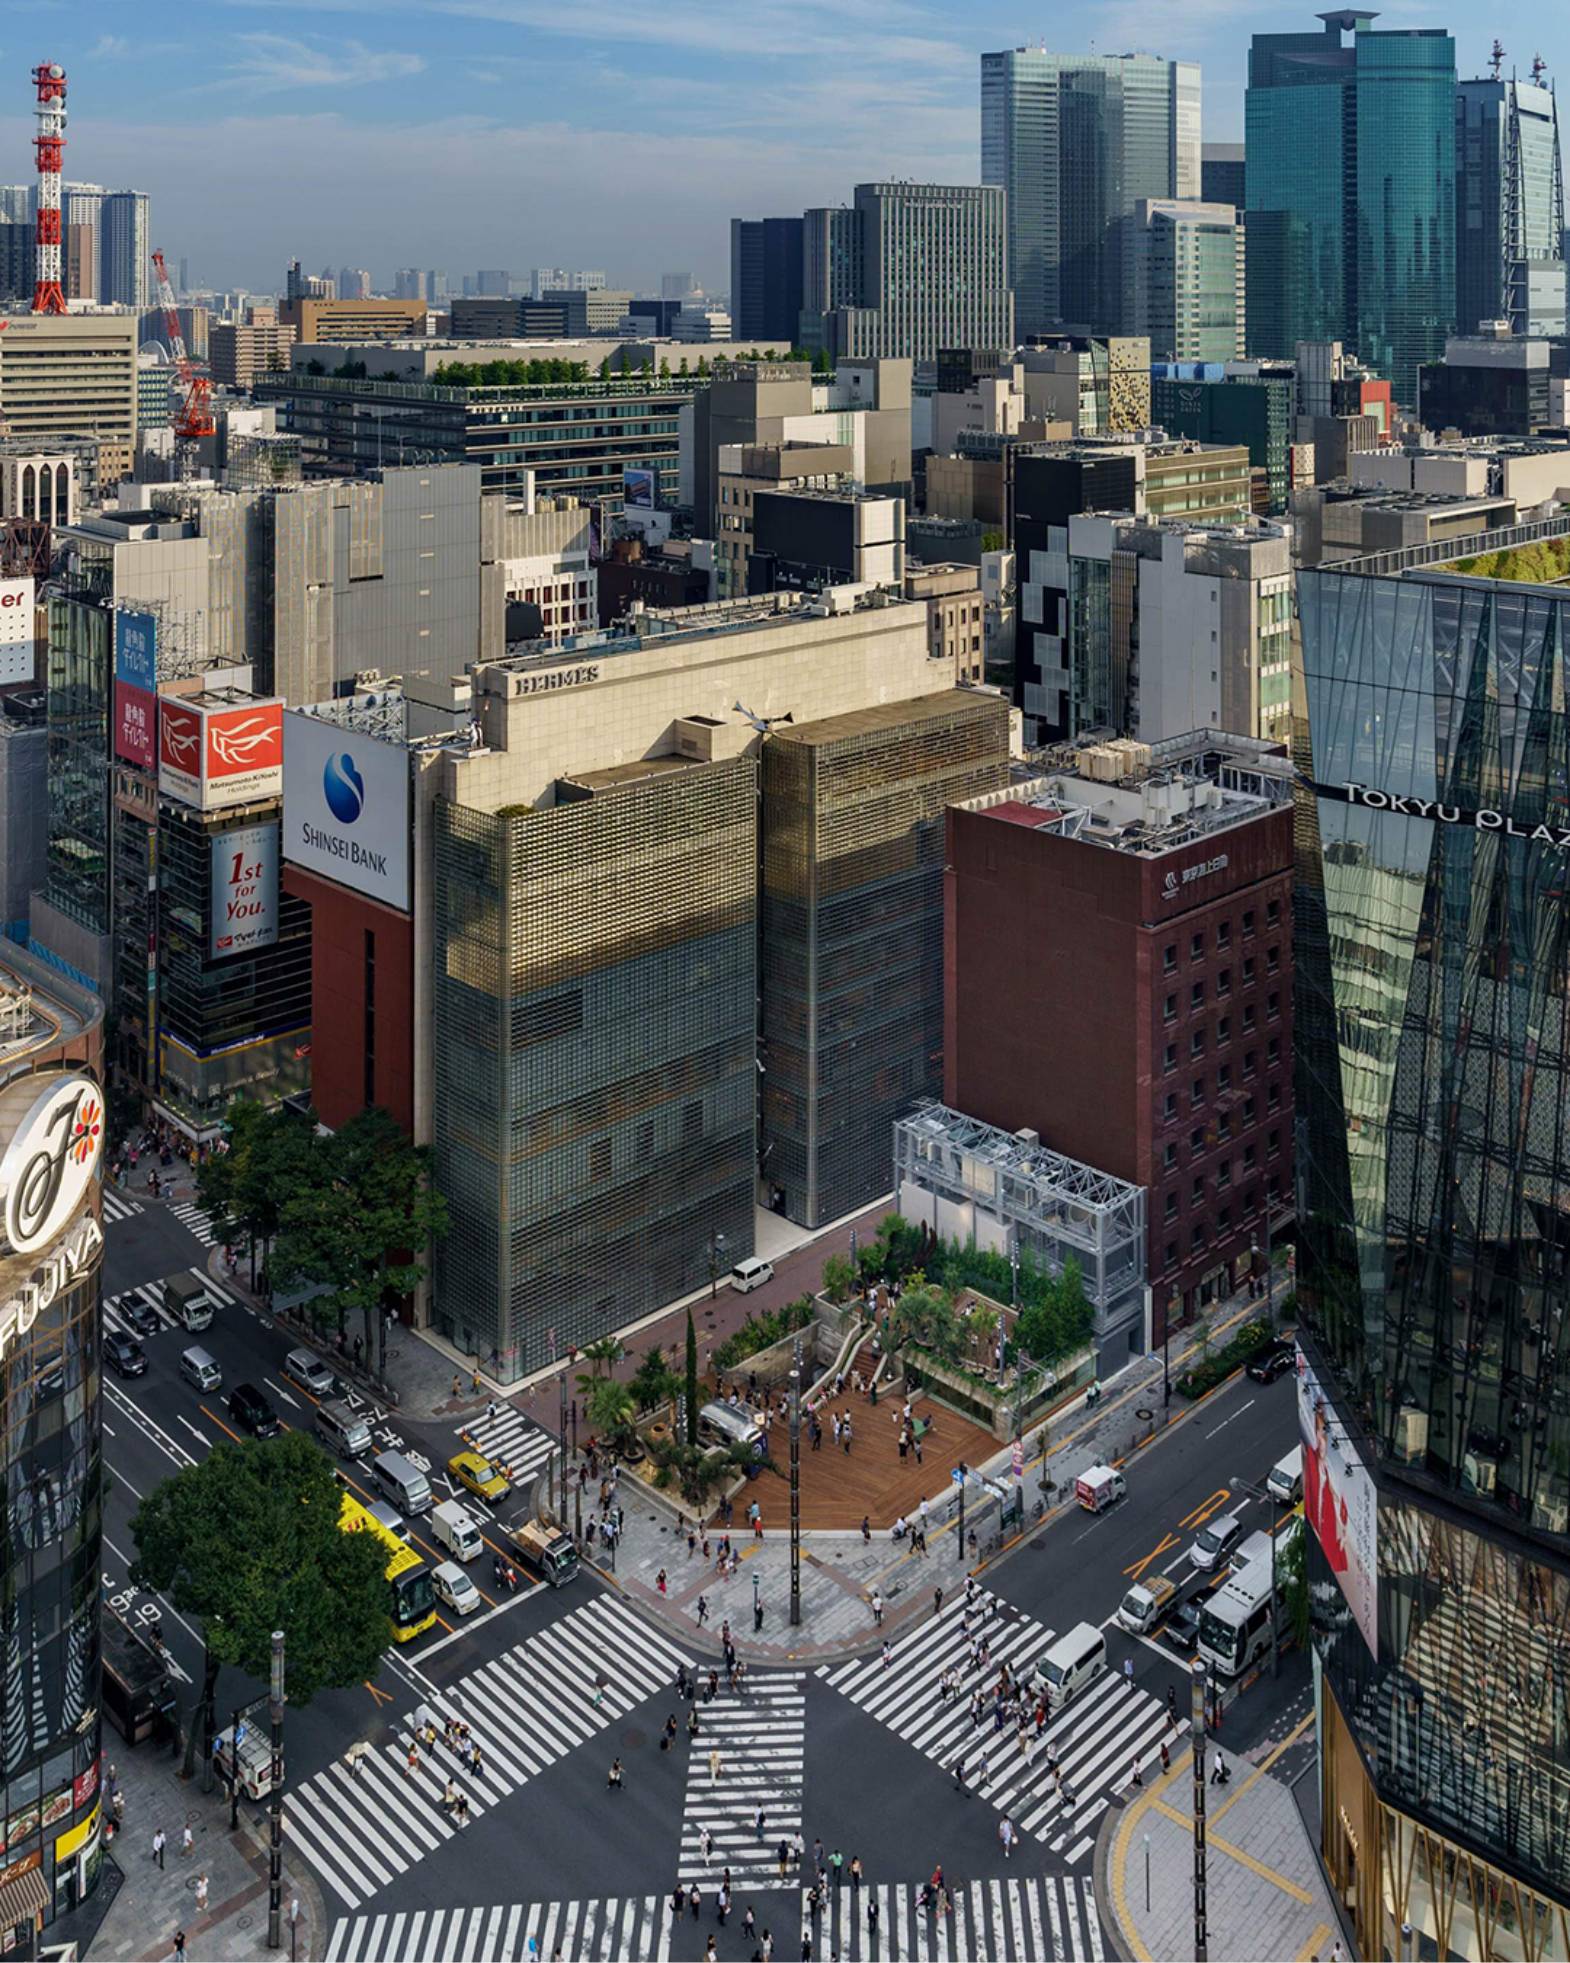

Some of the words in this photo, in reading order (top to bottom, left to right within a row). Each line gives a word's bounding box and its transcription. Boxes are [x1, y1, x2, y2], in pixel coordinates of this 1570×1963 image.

[1342, 781, 1460, 823] TOKYU
[228, 851, 264, 885] 1st
[303, 822, 350, 861] SHINSEI
[351, 841, 387, 877] BANK
[235, 884, 256, 899] for
